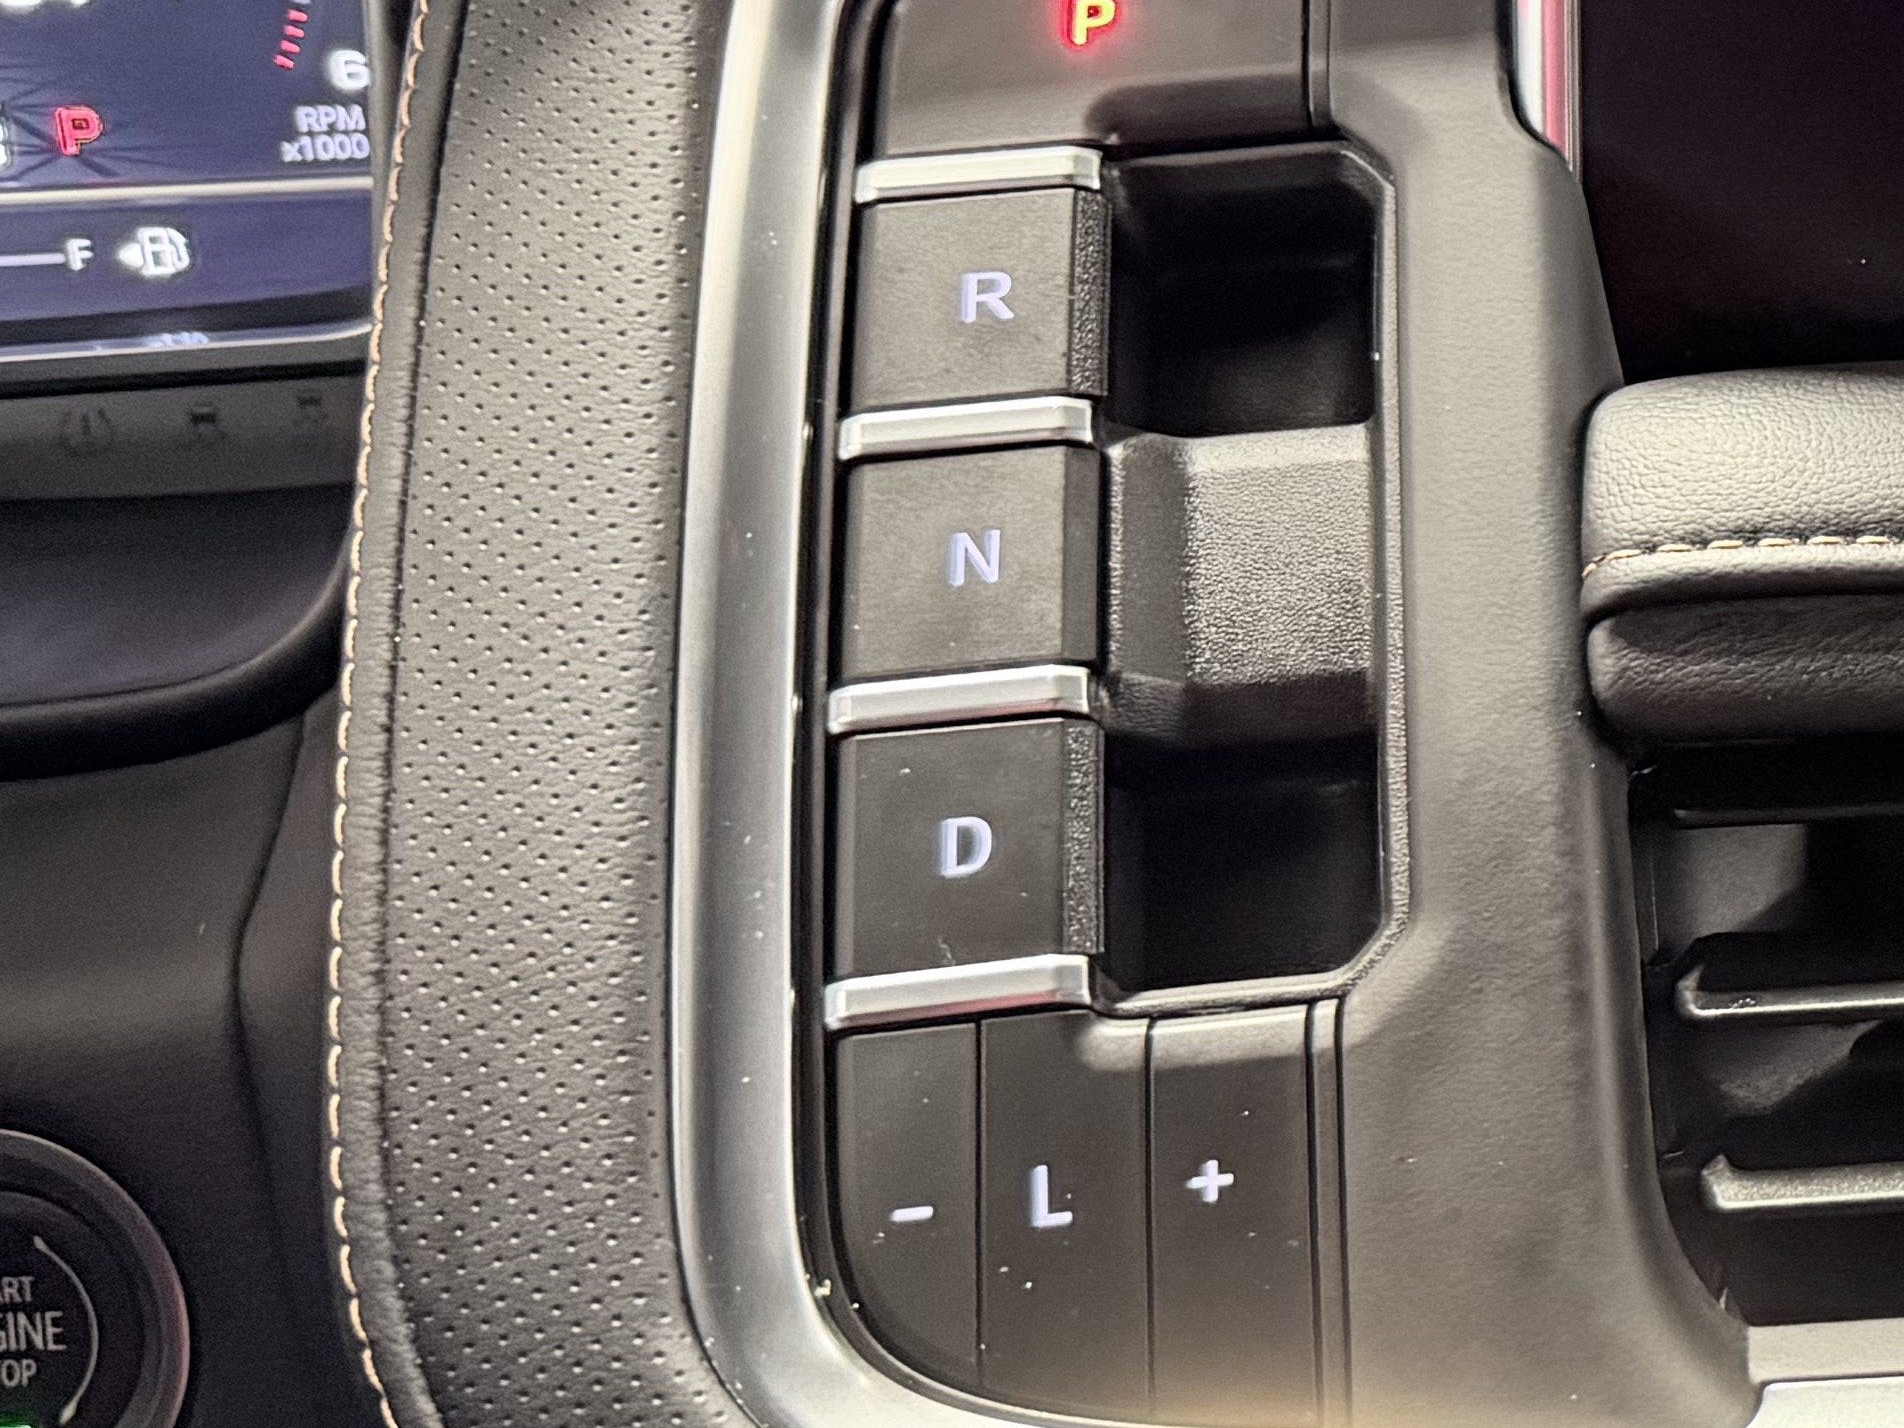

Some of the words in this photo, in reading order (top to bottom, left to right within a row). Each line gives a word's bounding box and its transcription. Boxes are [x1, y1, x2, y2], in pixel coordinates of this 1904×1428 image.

[328, 47, 371, 93] 6
[54, 104, 104, 157] P
[293, 103, 368, 135] RPM
[278, 132, 371, 164] x1000
[64, 237, 95, 272] F
[960, 270, 1016, 325] R
[951, 528, 1002, 588] N
[939, 815, 994, 879] D
[1031, 1163, 1074, 1229] L
[0, 1275, 35, 1305] RT
[0, 1357, 38, 1388] OP
